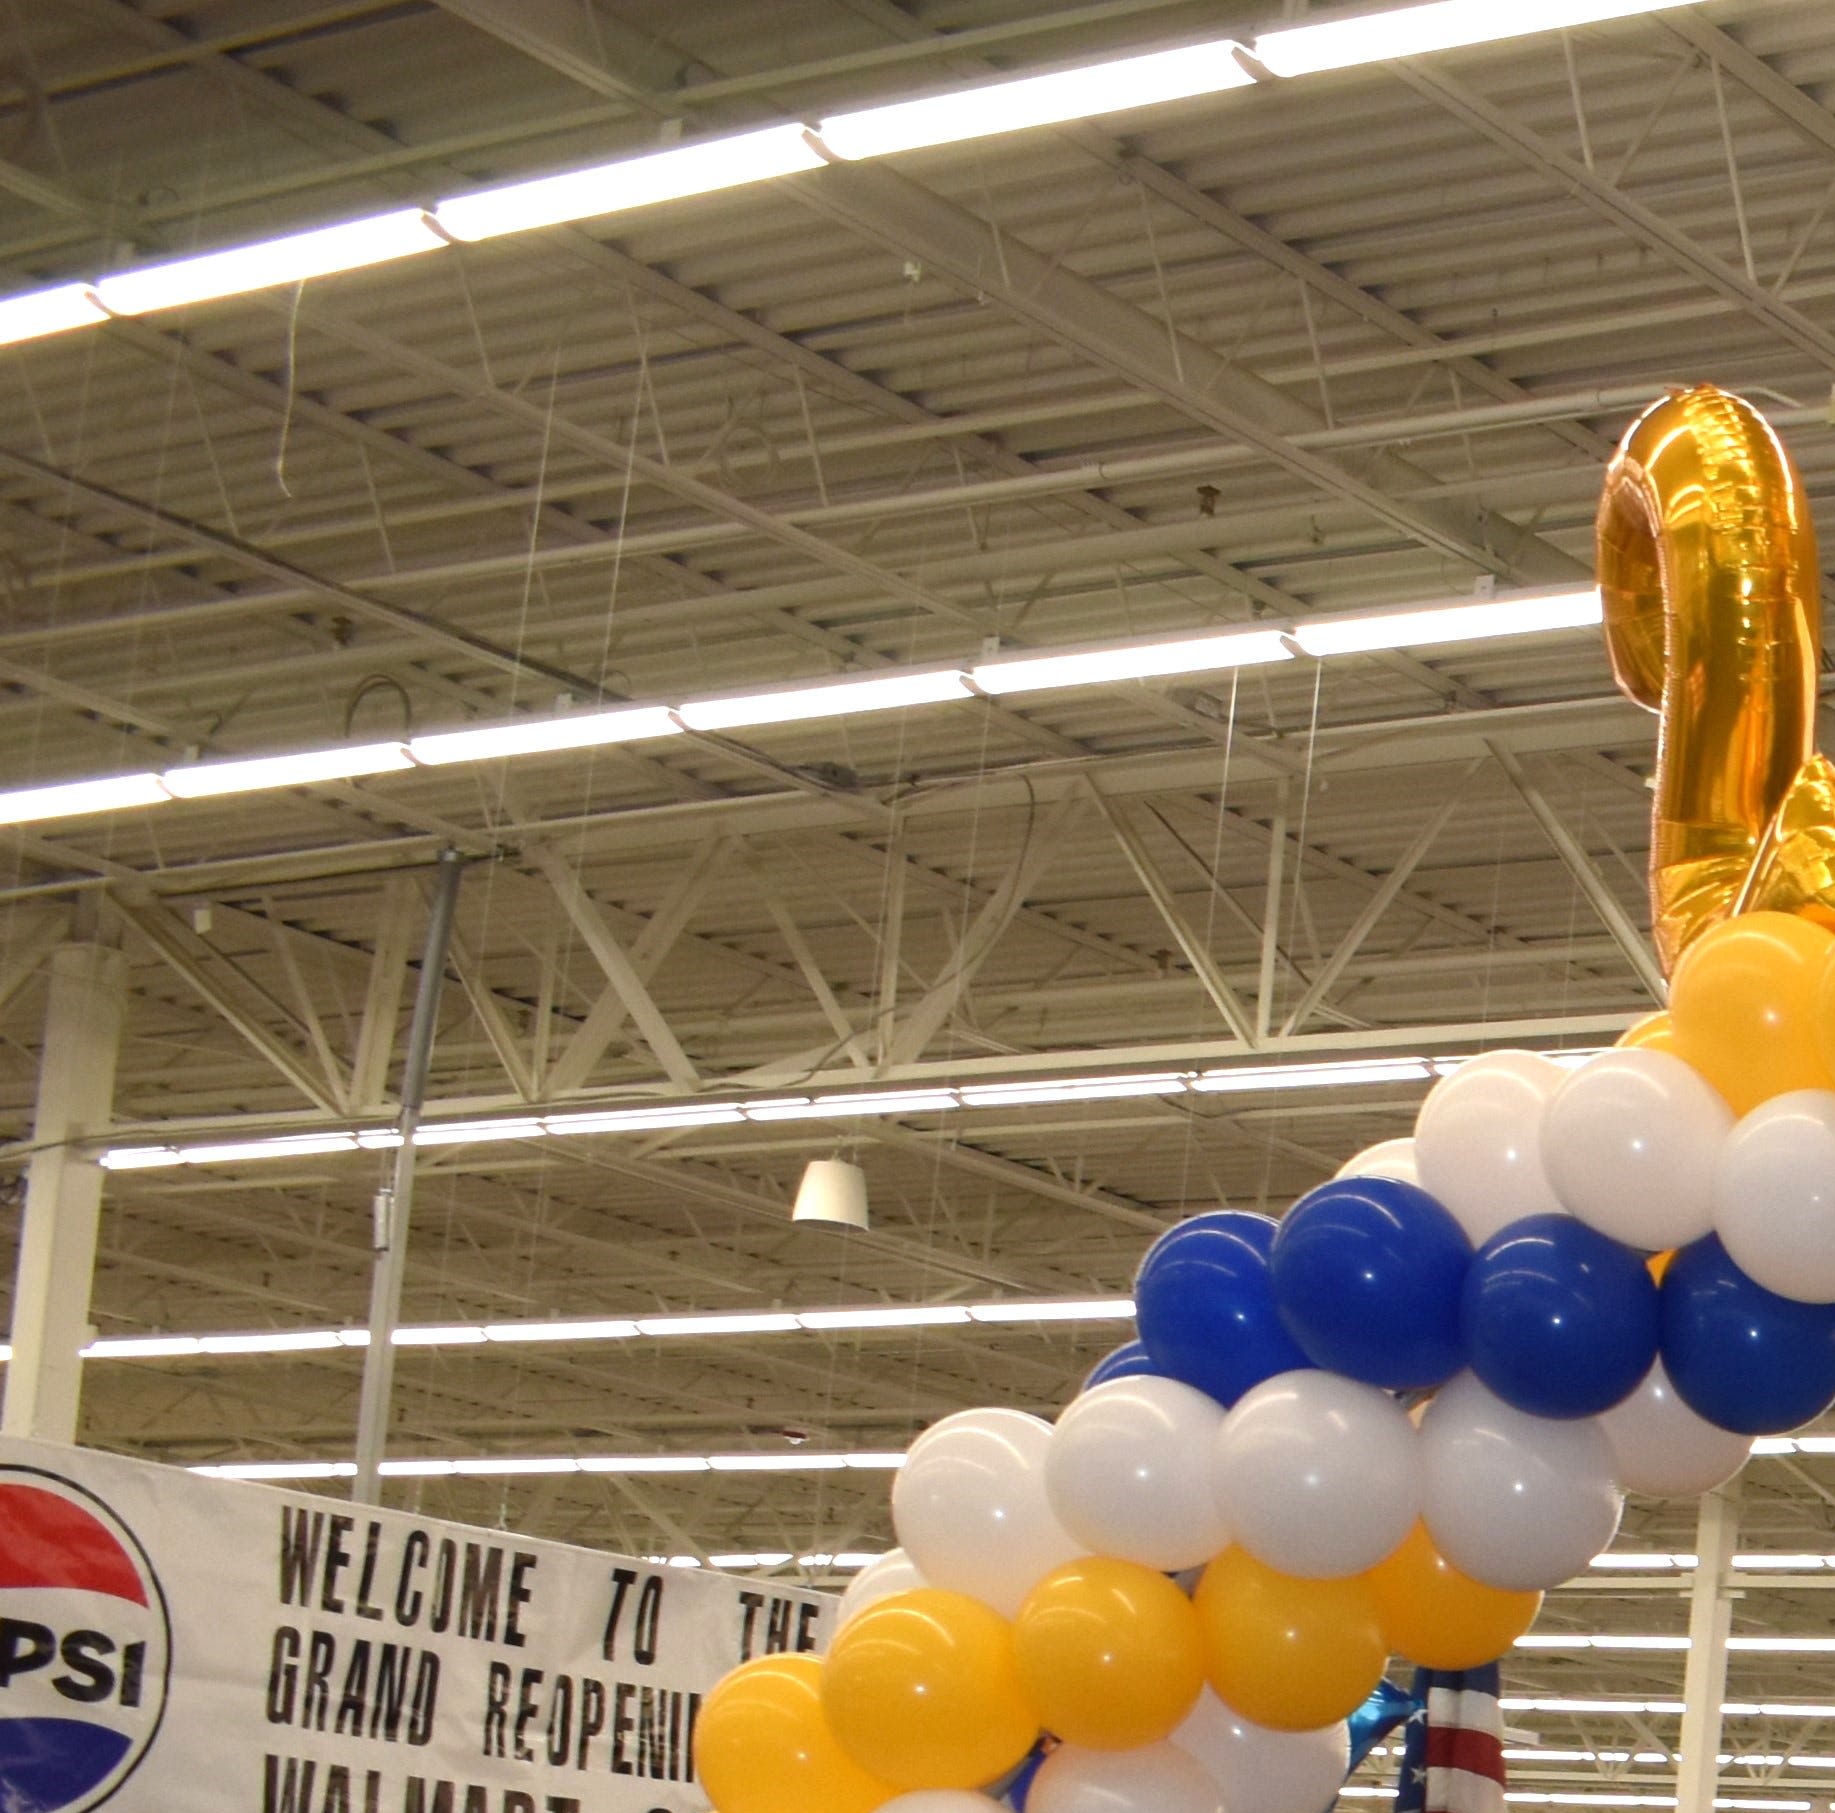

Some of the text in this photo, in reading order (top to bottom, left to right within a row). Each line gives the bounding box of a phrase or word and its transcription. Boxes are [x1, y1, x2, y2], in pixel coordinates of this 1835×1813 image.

[279, 1505, 820, 1666] WELCOME TO THE
[266, 1625, 441, 1747] GRAND
